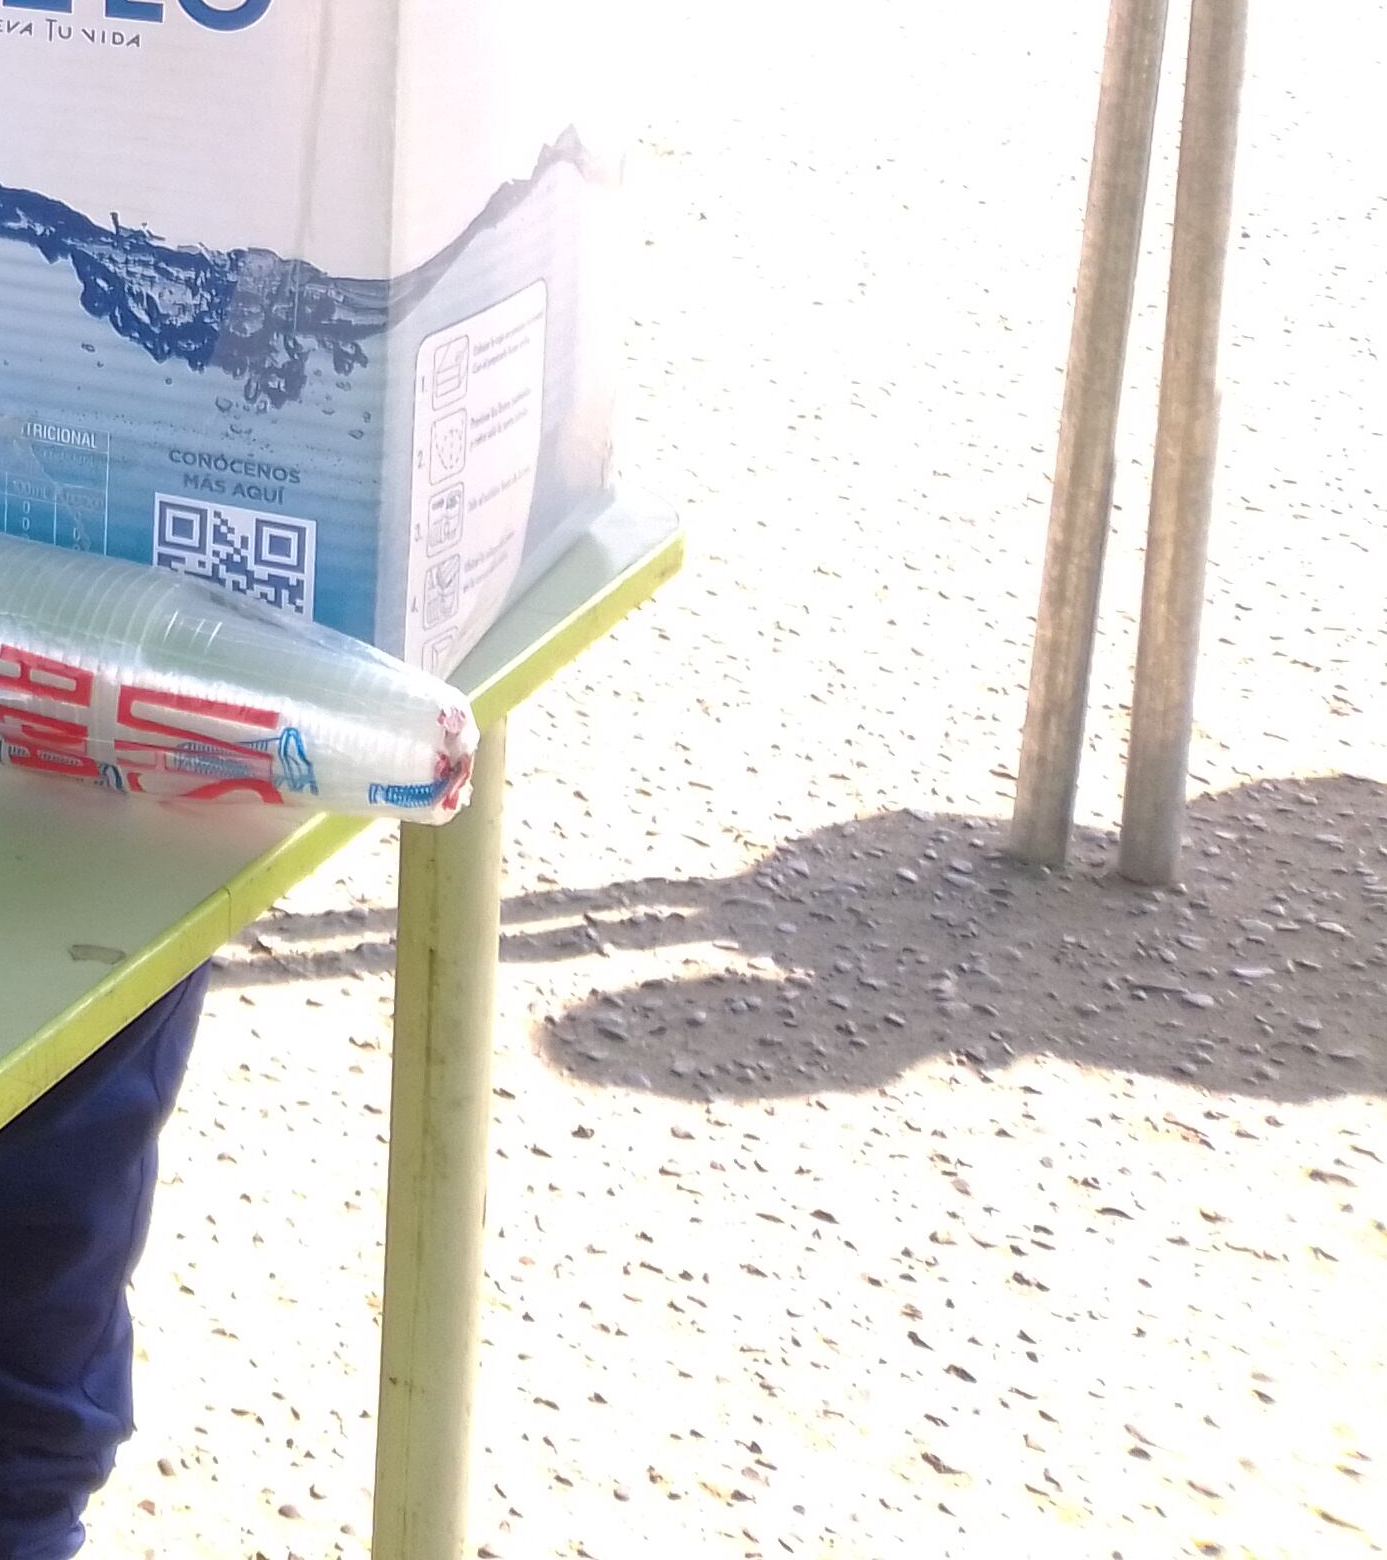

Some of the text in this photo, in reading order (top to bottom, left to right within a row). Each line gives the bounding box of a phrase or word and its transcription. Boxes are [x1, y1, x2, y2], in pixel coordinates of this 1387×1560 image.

[21, 421, 98, 450] TRICIONAL
[183, 472, 285, 506] MÁS AQUÍ
[115, 683, 285, 806] VAS
